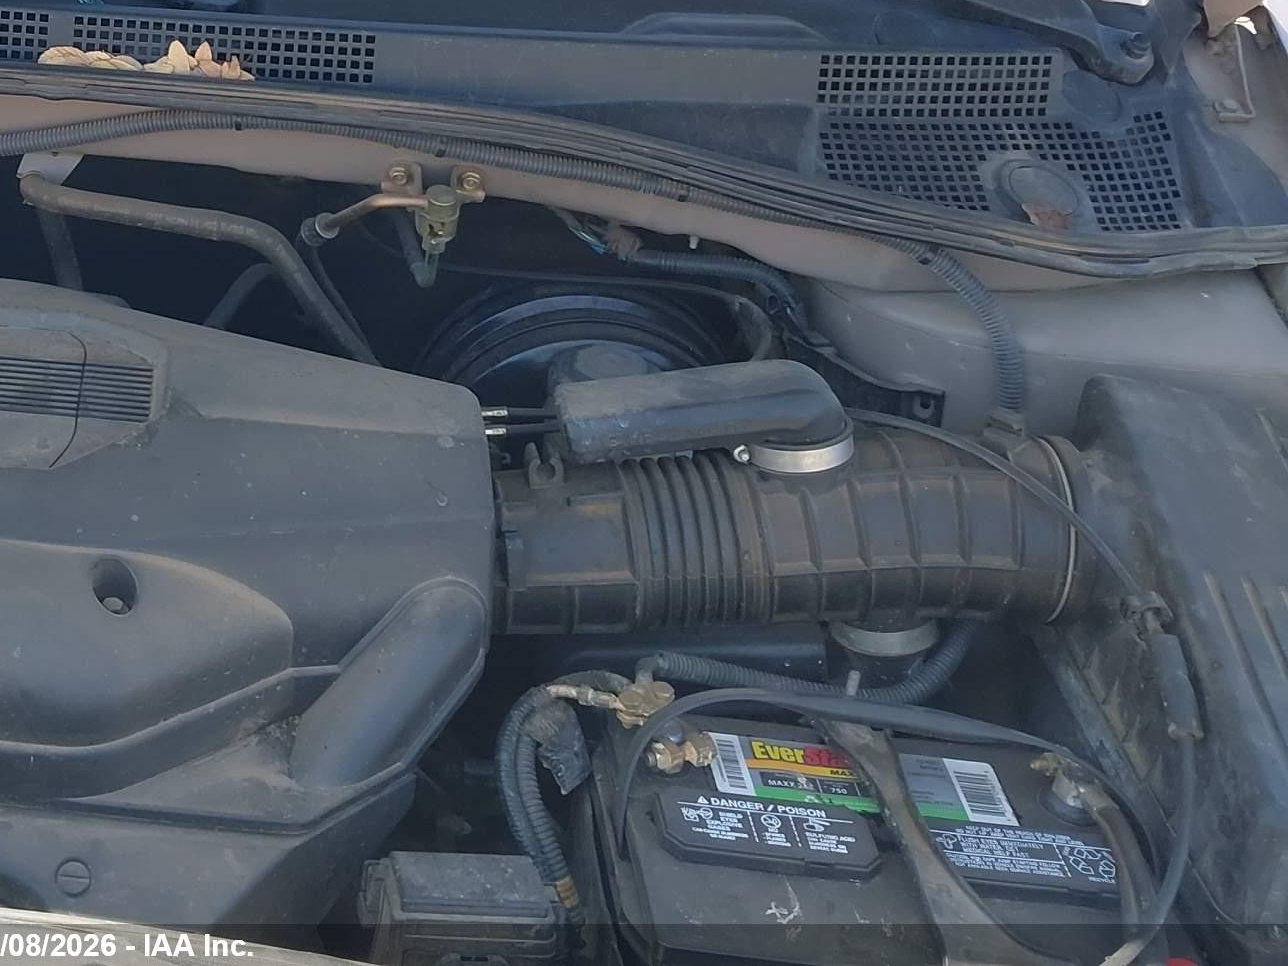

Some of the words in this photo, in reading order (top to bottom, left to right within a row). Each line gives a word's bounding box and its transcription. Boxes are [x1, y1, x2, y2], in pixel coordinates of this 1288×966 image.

[710, 797, 763, 812] DANGER
[766, 804, 774, 812] /
[777, 805, 826, 818] POISON
